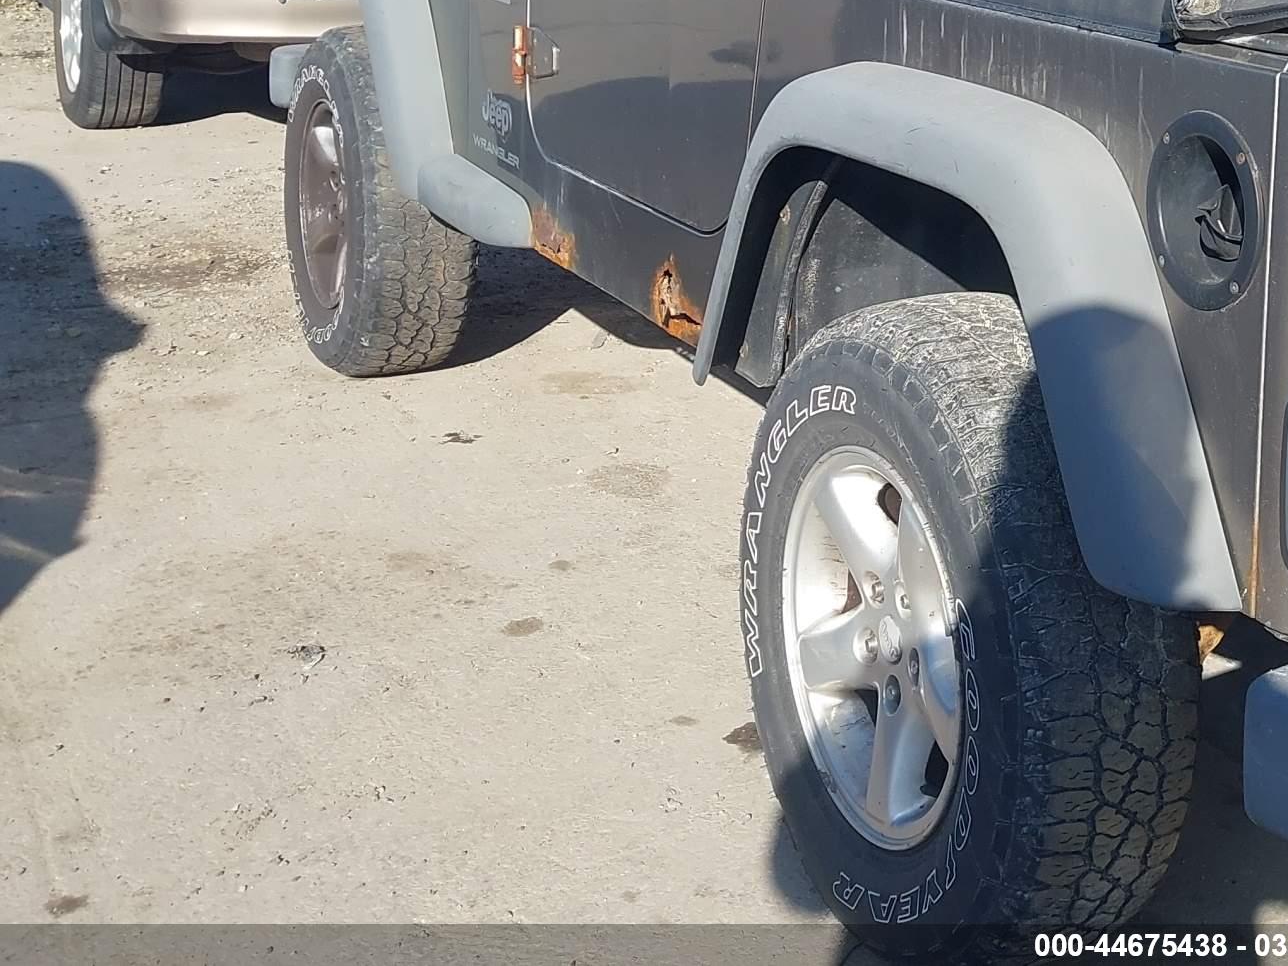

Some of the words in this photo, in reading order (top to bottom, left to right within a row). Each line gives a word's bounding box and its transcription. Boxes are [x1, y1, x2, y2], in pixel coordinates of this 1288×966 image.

[473, 133, 520, 170] WRANGLER
[482, 89, 511, 136] Jeep
[743, 384, 857, 678] WRANGLER
[832, 598, 981, 925] GOODYEAR
